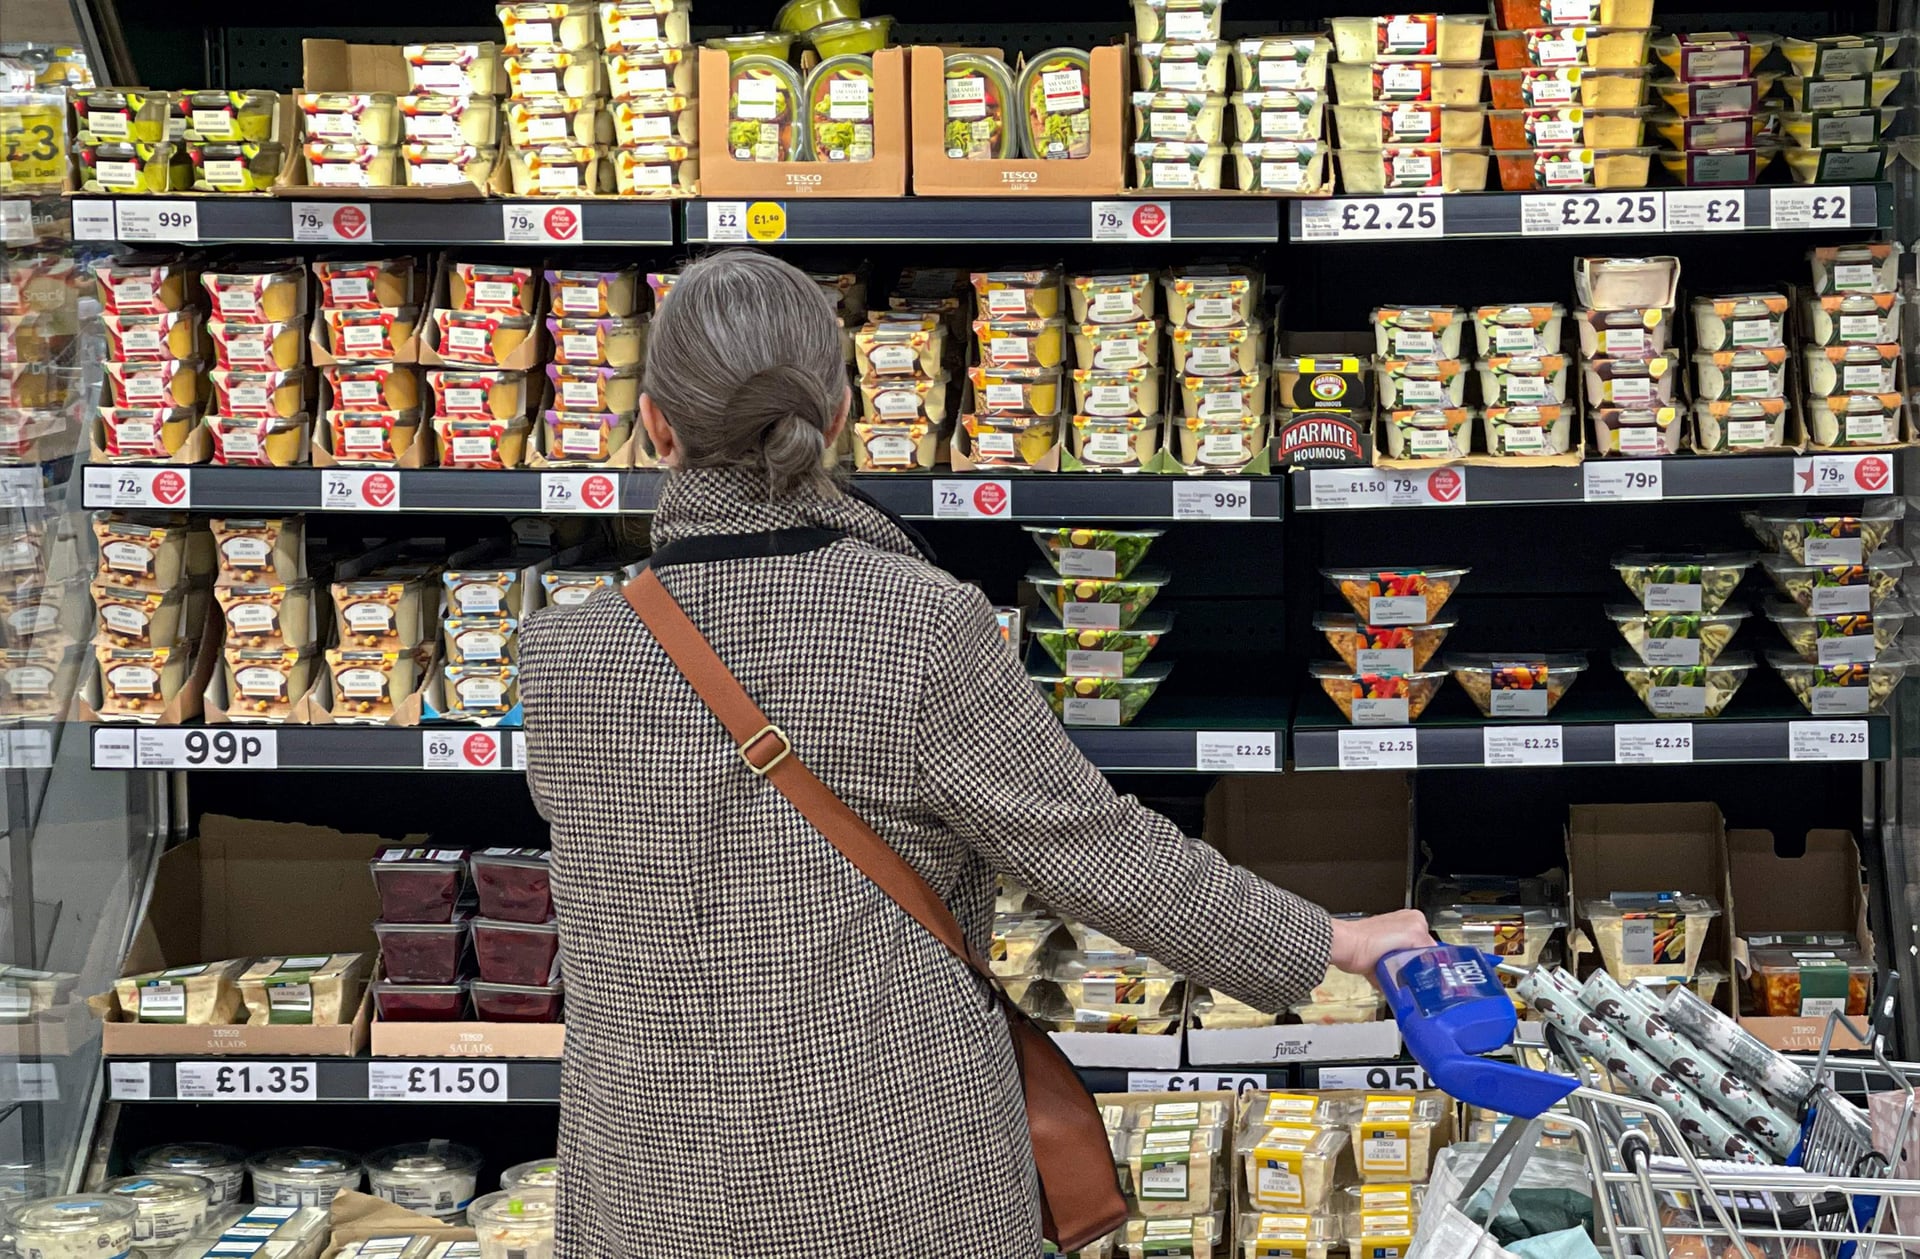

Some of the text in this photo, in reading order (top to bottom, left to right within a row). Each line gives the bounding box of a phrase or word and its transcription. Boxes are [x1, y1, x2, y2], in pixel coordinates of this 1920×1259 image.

[786, 174, 822, 182] TESCO
[1001, 171, 1038, 179] TESCO
[1562, 197, 1655, 224] £2.25
[1707, 200, 1740, 222] £2
[1813, 197, 1845, 219] £2
[159, 213, 191, 226] 99p
[299, 215, 323, 228] 79p
[719, 215, 736, 226] £2
[1099, 214, 1122, 227] 79p
[1342, 203, 1435, 230] £2.25
[511, 217, 534, 230] 79p
[1315, 376, 1342, 386] MARMITE
[1285, 422, 1353, 450] MARMITE
[1294, 447, 1346, 462] HOUMOUS
[1625, 473, 1657, 488] 79p
[1821, 468, 1844, 481] 79p
[119, 480, 141, 494] 72p
[329, 483, 351, 496] 72p
[370, 481, 387, 489] Price
[1351, 482, 1385, 492] £1.50
[1394, 480, 1417, 492] 79p
[549, 486, 571, 499] 72p
[941, 493, 963, 505] 72p
[1215, 494, 1246, 507] 99p
[1525, 739, 1559, 748] £2.25
[1656, 738, 1689, 747] £2.25
[1831, 733, 1864, 743] £2.25
[185, 731, 261, 764] 99p
[430, 743, 454, 756] 69p
[1237, 746, 1271, 755] £2.25
[1380, 741, 1413, 751] £2.25
[1452, 960, 1487, 984] TESCO
[207, 1040, 246, 1048] SALADS
[449, 1044, 492, 1053] SALADS
[1272, 1042, 1308, 1058] finest
[217, 1067, 308, 1092] £1.35
[408, 1067, 499, 1093] £1.50
